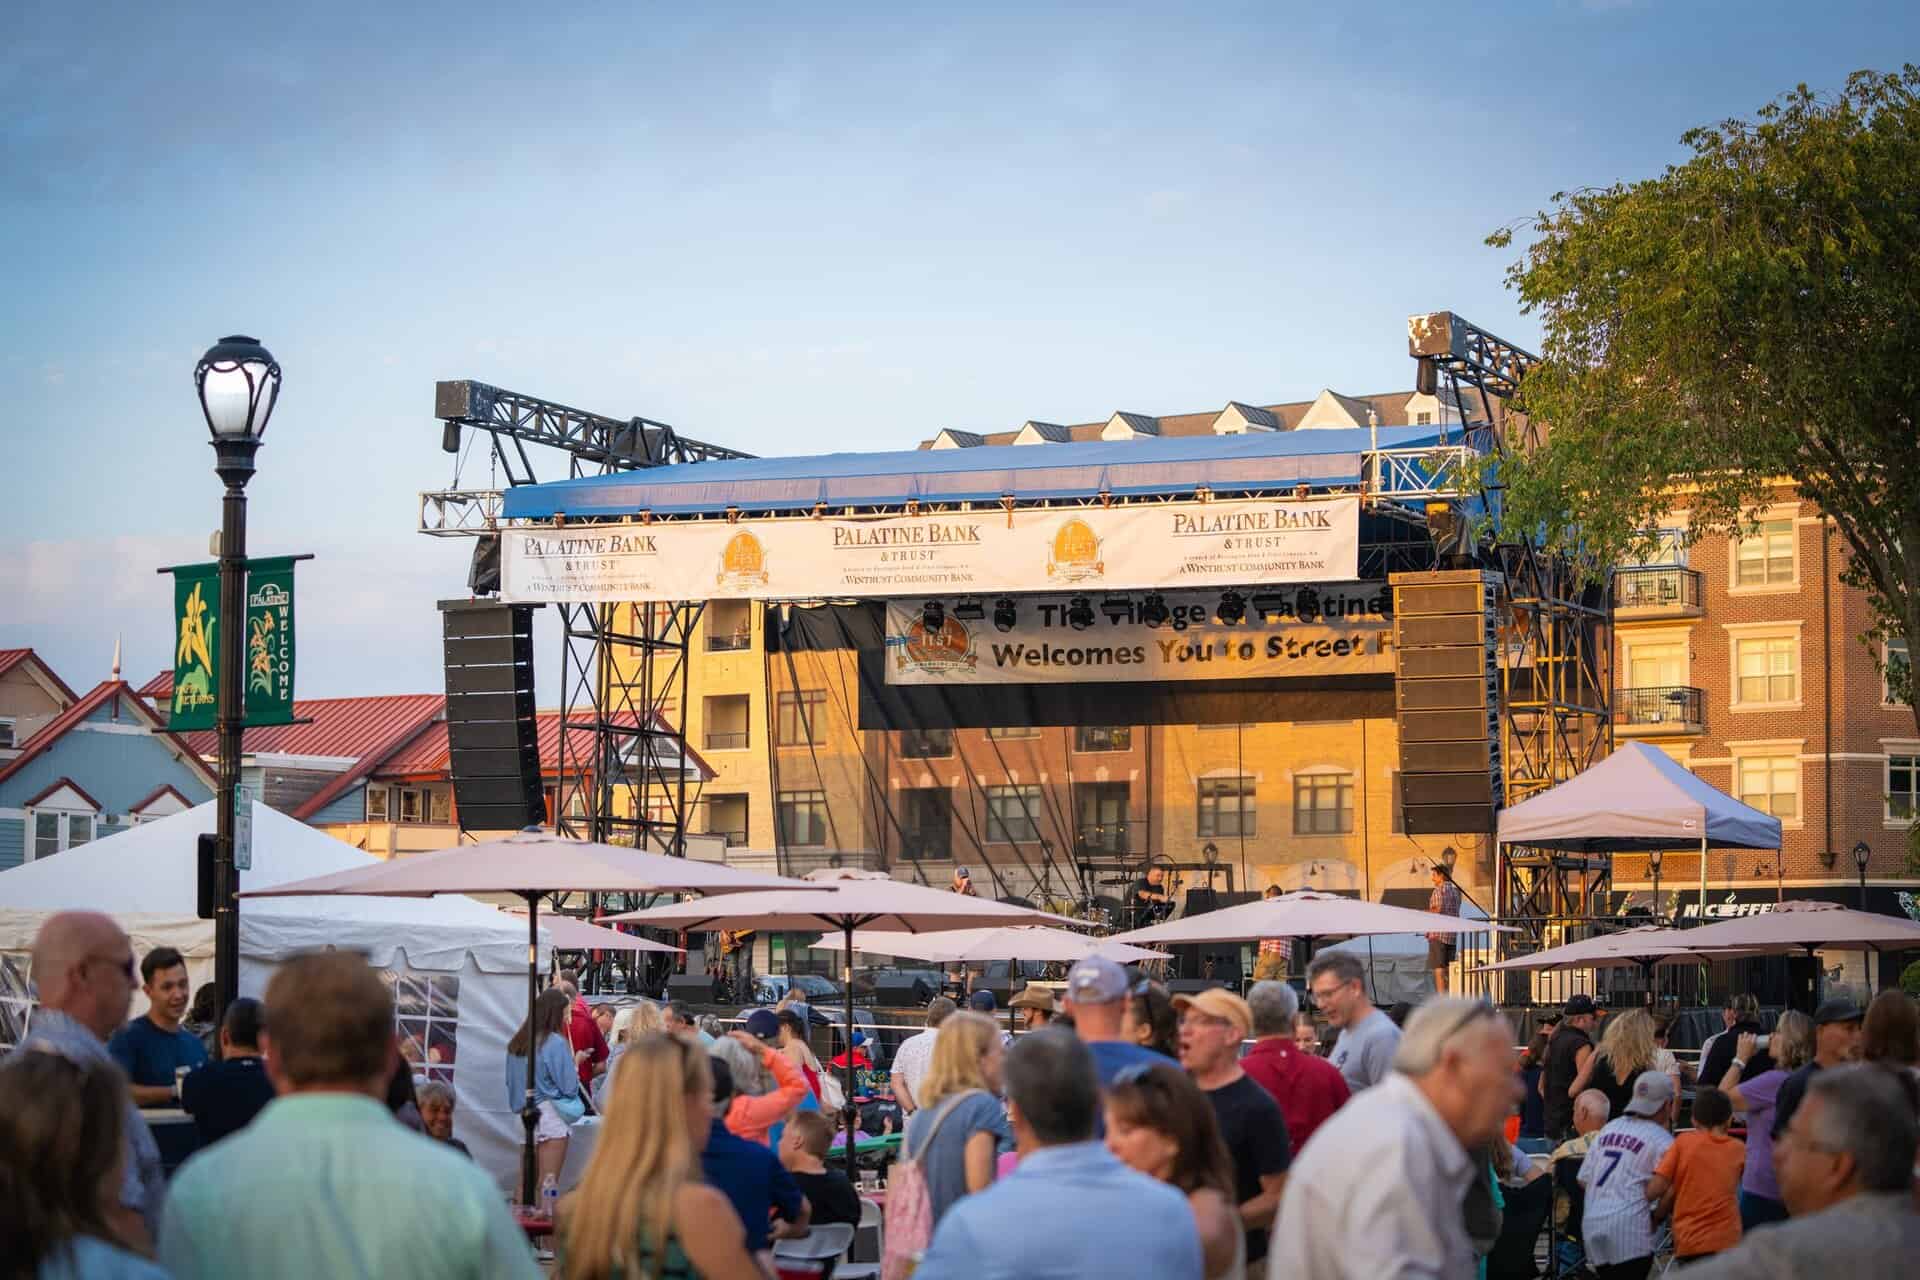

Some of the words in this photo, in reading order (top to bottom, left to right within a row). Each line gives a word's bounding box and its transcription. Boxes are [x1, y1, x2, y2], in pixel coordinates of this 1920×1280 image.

[1173, 512, 1269, 533] PALATINE
[1274, 509, 1331, 529] BANK
[833, 526, 924, 545] PALATINE
[928, 523, 981, 542] BANK
[1223, 538, 1232, 550] &
[1235, 536, 1281, 549] TRUST
[523, 537, 606, 555] PALATINE
[610, 535, 657, 553] BANK
[565, 560, 573, 571] &
[576, 559, 616, 570] TRUST
[880, 551, 888, 562] &
[891, 550, 936, 561] TRUST
[1179, 566, 1186, 574] A
[1187, 562, 1238, 573] WINTRUST
[1239, 561, 1297, 572] COMMUNITY
[1299, 559, 1325, 570] BANK
[846, 575, 894, 585] WINTRUST
[894, 574, 949, 584] COMMUNITY
[950, 573, 974, 582] BANK
[1037, 603, 1091, 628] Th
[280, 606, 289, 700] WELCOME
[992, 643, 1145, 667] Welcomes
[1156, 639, 1213, 663] You
[1223, 639, 1256, 661] to
[1266, 635, 1365, 659] Street
[1597, 1150, 1622, 1186] 7
